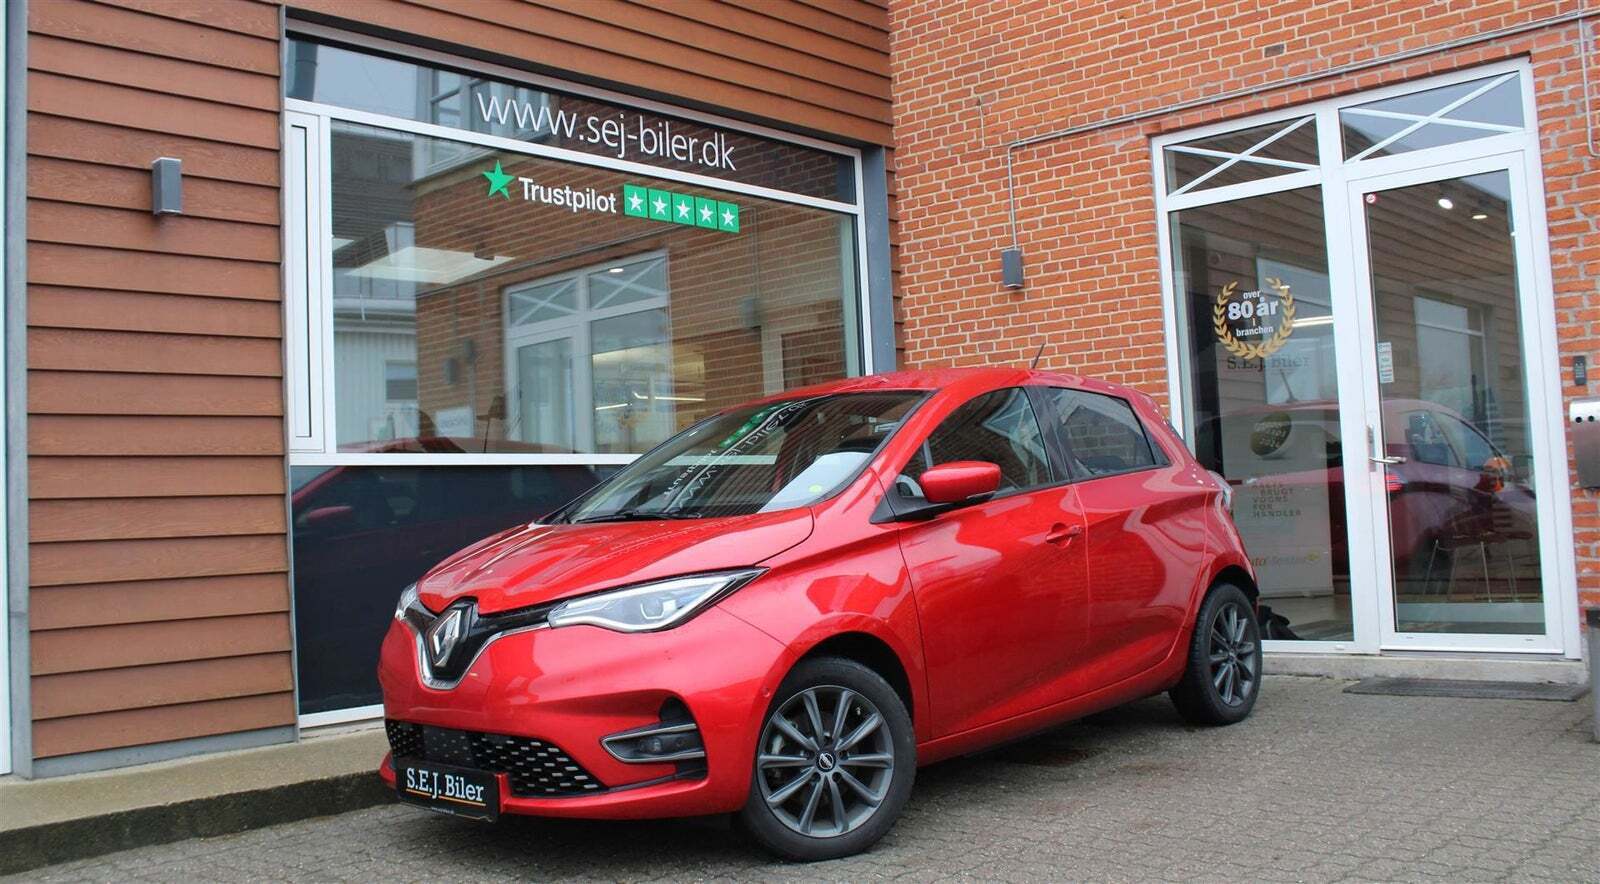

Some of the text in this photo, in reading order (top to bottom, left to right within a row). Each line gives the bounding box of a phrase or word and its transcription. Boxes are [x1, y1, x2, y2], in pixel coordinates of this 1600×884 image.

[476, 92, 737, 171] www.sej-biler.dk
[518, 176, 617, 213] Trustpilot
[1228, 296, 1279, 320] 80 år
[1243, 290, 1261, 299] over
[1236, 326, 1274, 336] branchen
[406, 767, 484, 801] S.E.J. Biler
